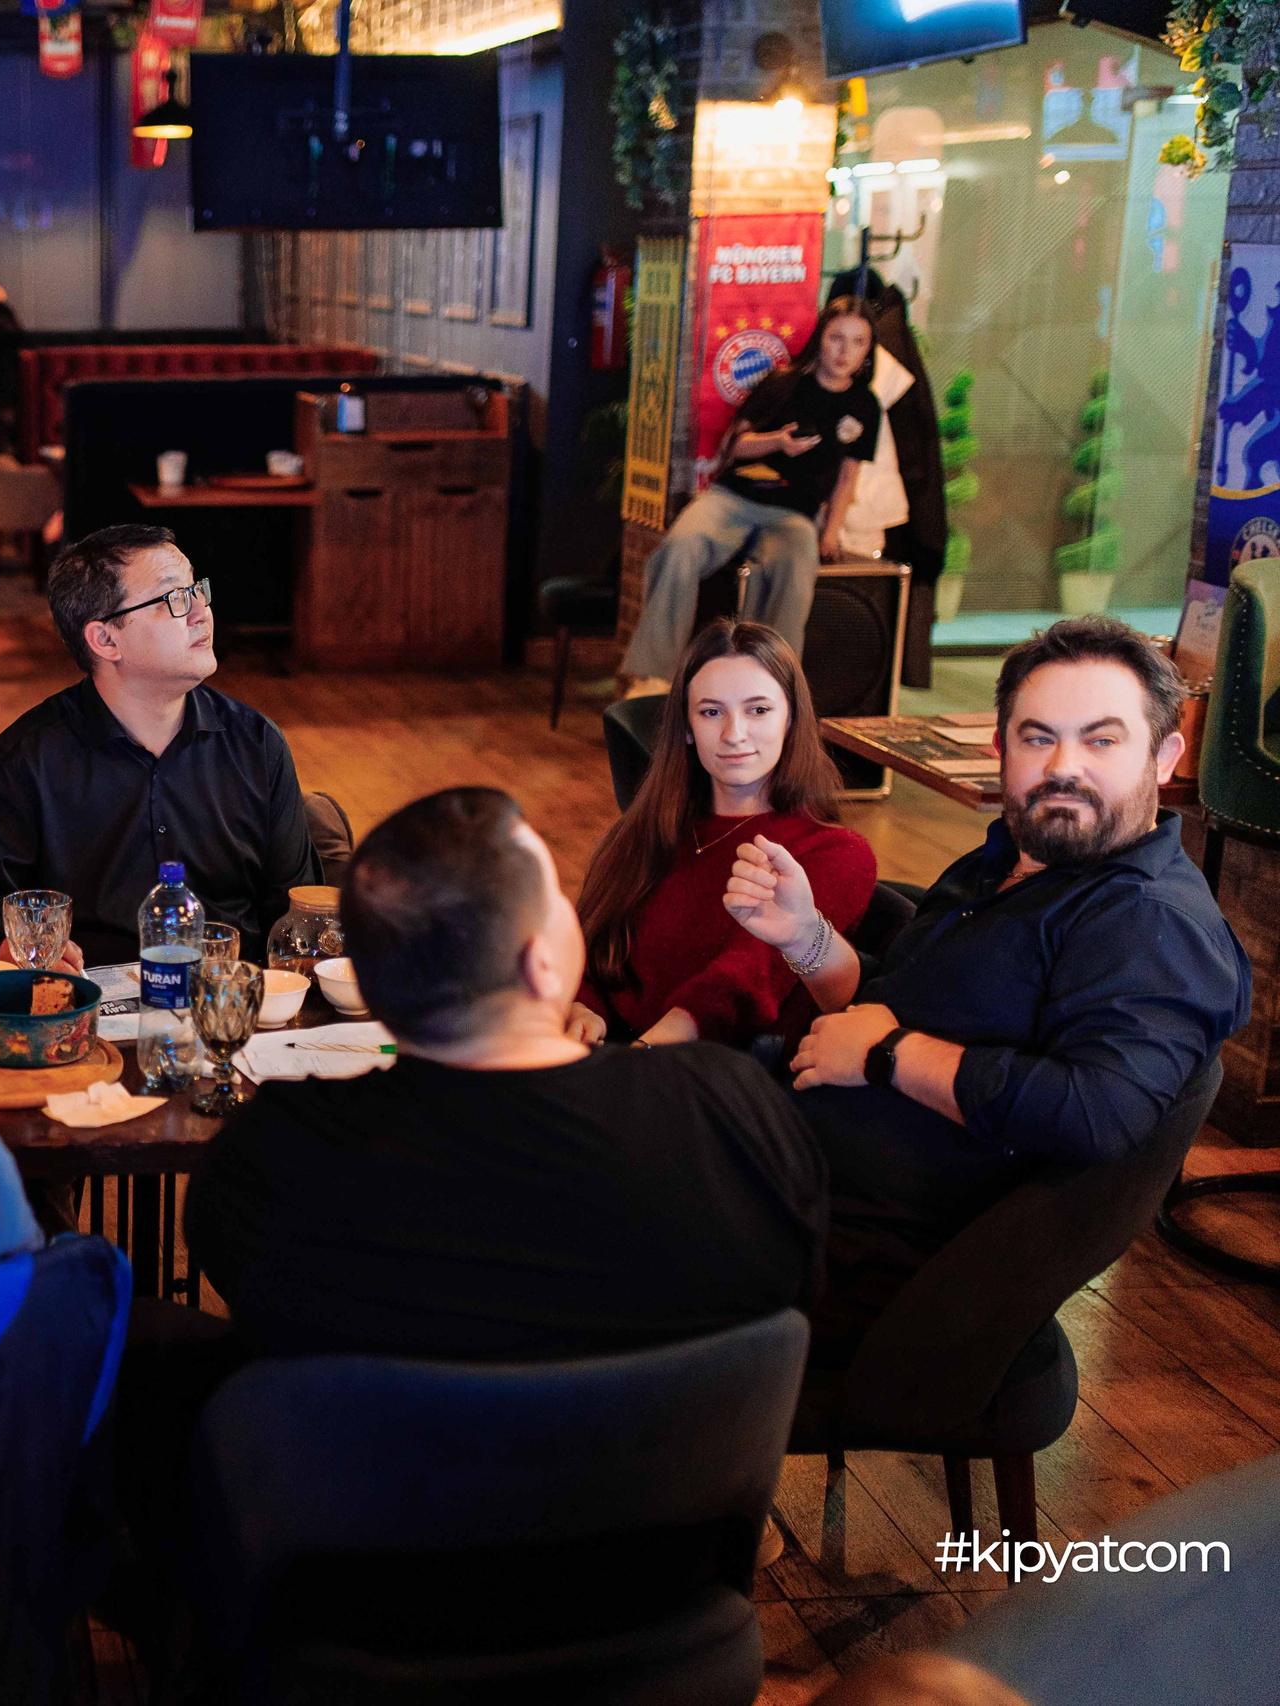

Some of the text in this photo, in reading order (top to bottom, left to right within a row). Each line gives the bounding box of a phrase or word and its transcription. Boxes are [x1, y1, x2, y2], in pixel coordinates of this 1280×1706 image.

[716, 243, 803, 264] MÜNCHEN
[708, 264, 806, 284] FC BAYERN
[142, 970, 181, 985] TURAN
